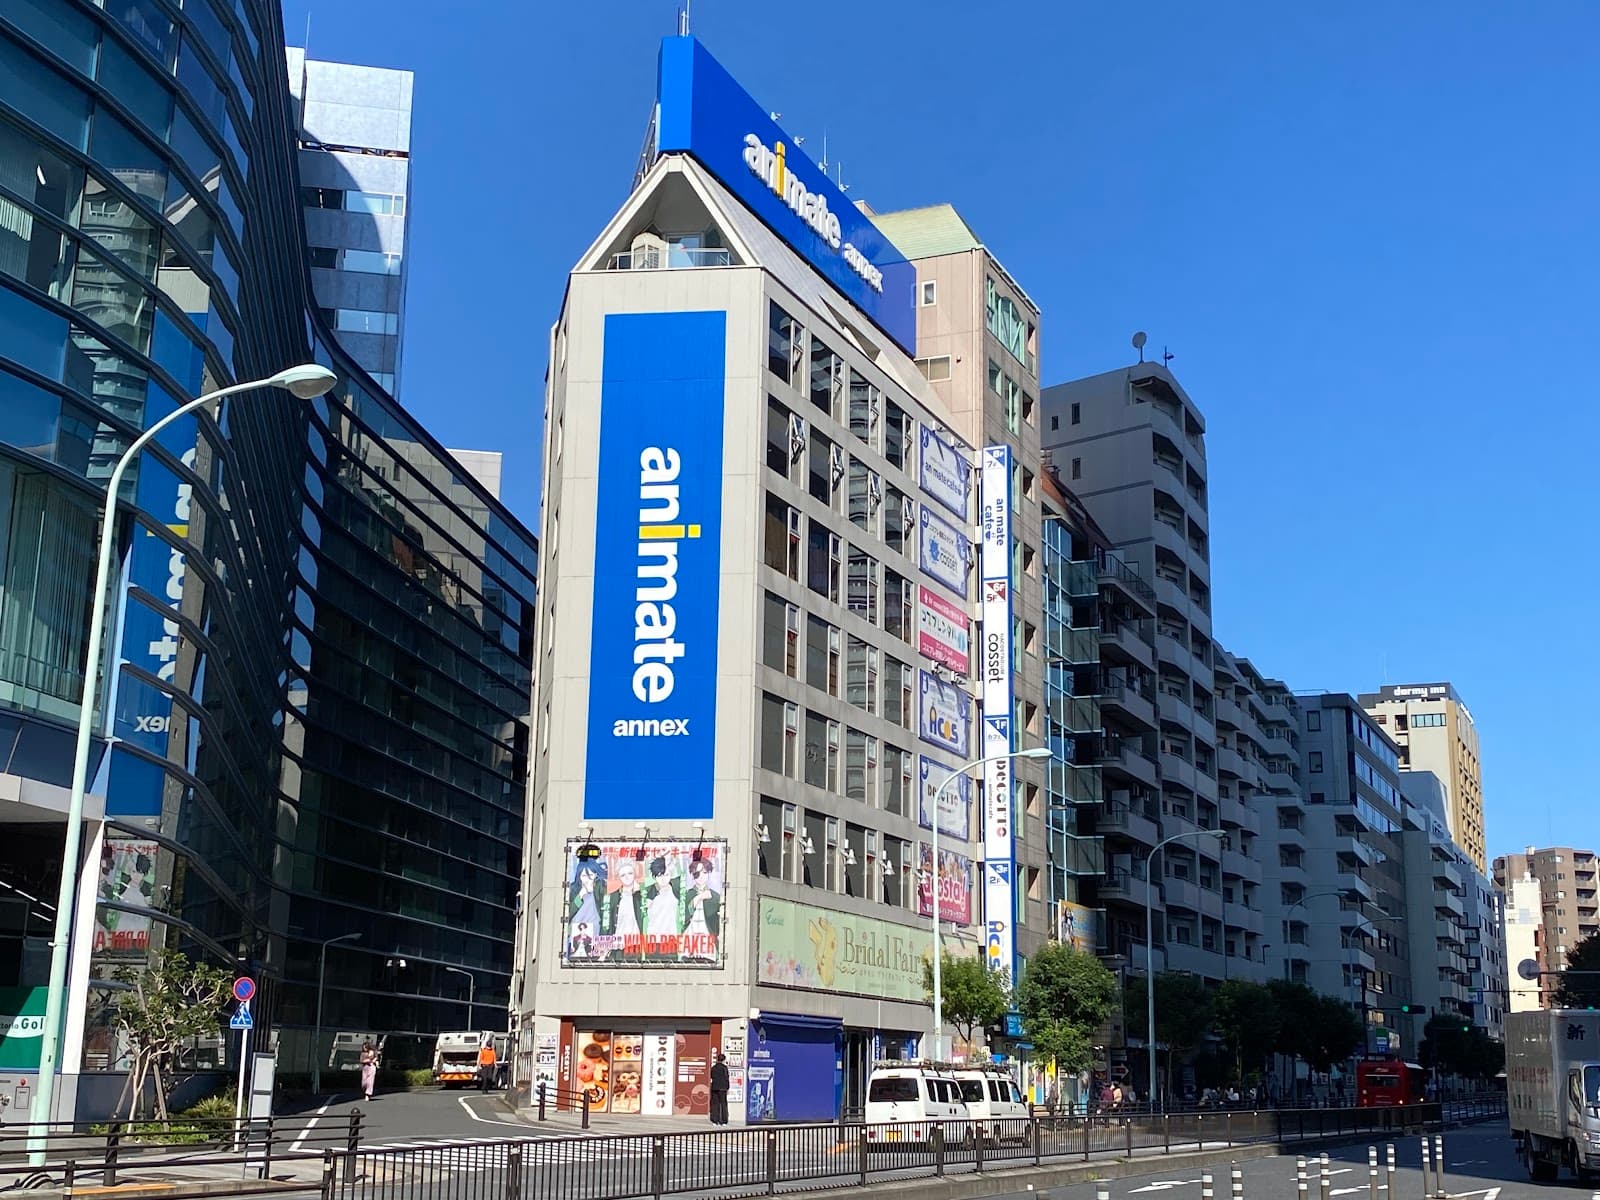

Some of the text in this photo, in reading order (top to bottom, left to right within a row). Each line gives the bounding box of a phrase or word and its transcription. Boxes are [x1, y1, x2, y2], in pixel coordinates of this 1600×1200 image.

[743, 133, 884, 293] animate annex
[985, 505, 994, 530] cafe
[632, 446, 701, 703] animate
[993, 582, 1005, 592] 6F
[986, 593, 997, 602] 5F
[988, 633, 1003, 684] cosset
[1394, 686, 1428, 698] dormy
[613, 718, 690, 737] annex
[995, 719, 1007, 730] 1F
[996, 864, 1008, 874] 3F
[989, 876, 1001, 884] 2F
[623, 933, 657, 955] WIND
[660, 933, 715, 955] BREAKER
[842, 926, 921, 974] Bridal Fair
[21, 1017, 44, 1030] Gol
